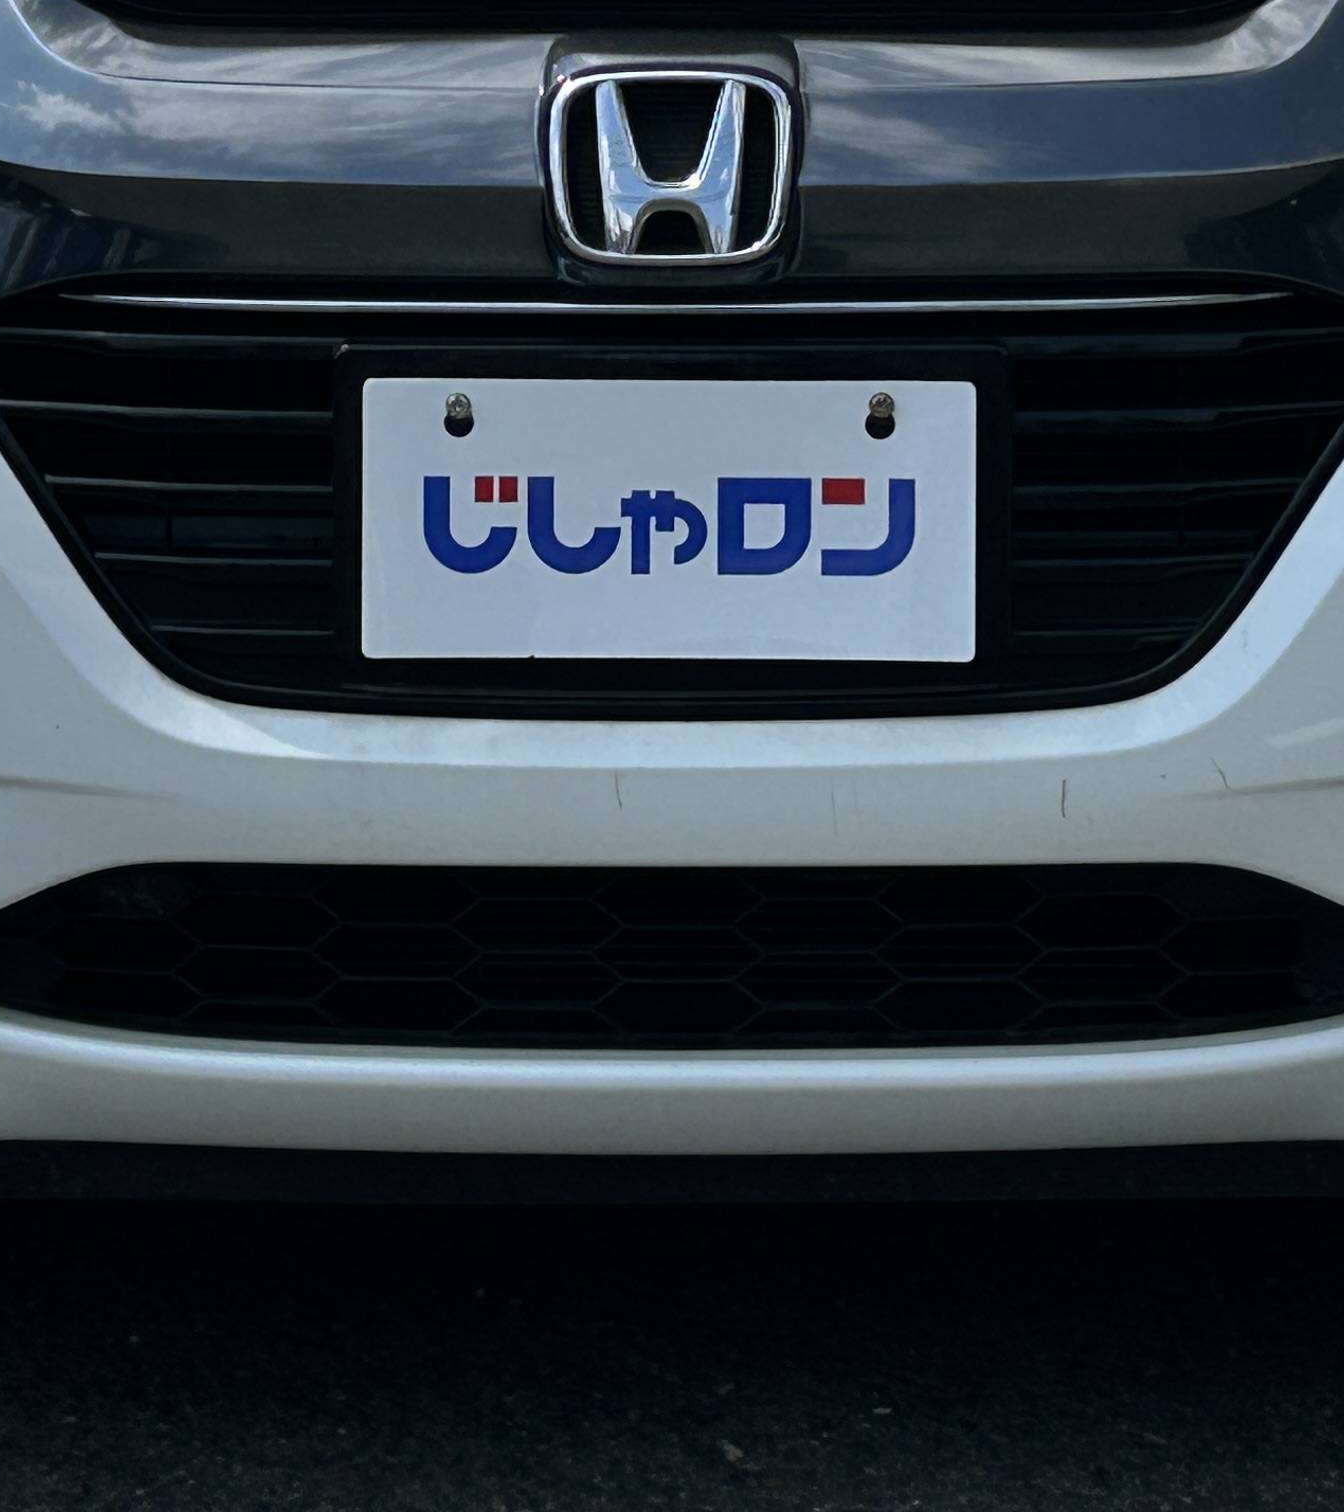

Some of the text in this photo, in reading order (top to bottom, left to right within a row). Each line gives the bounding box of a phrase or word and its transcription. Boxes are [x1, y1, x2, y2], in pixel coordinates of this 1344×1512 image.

[422, 475, 916, 577] じしゃロン
